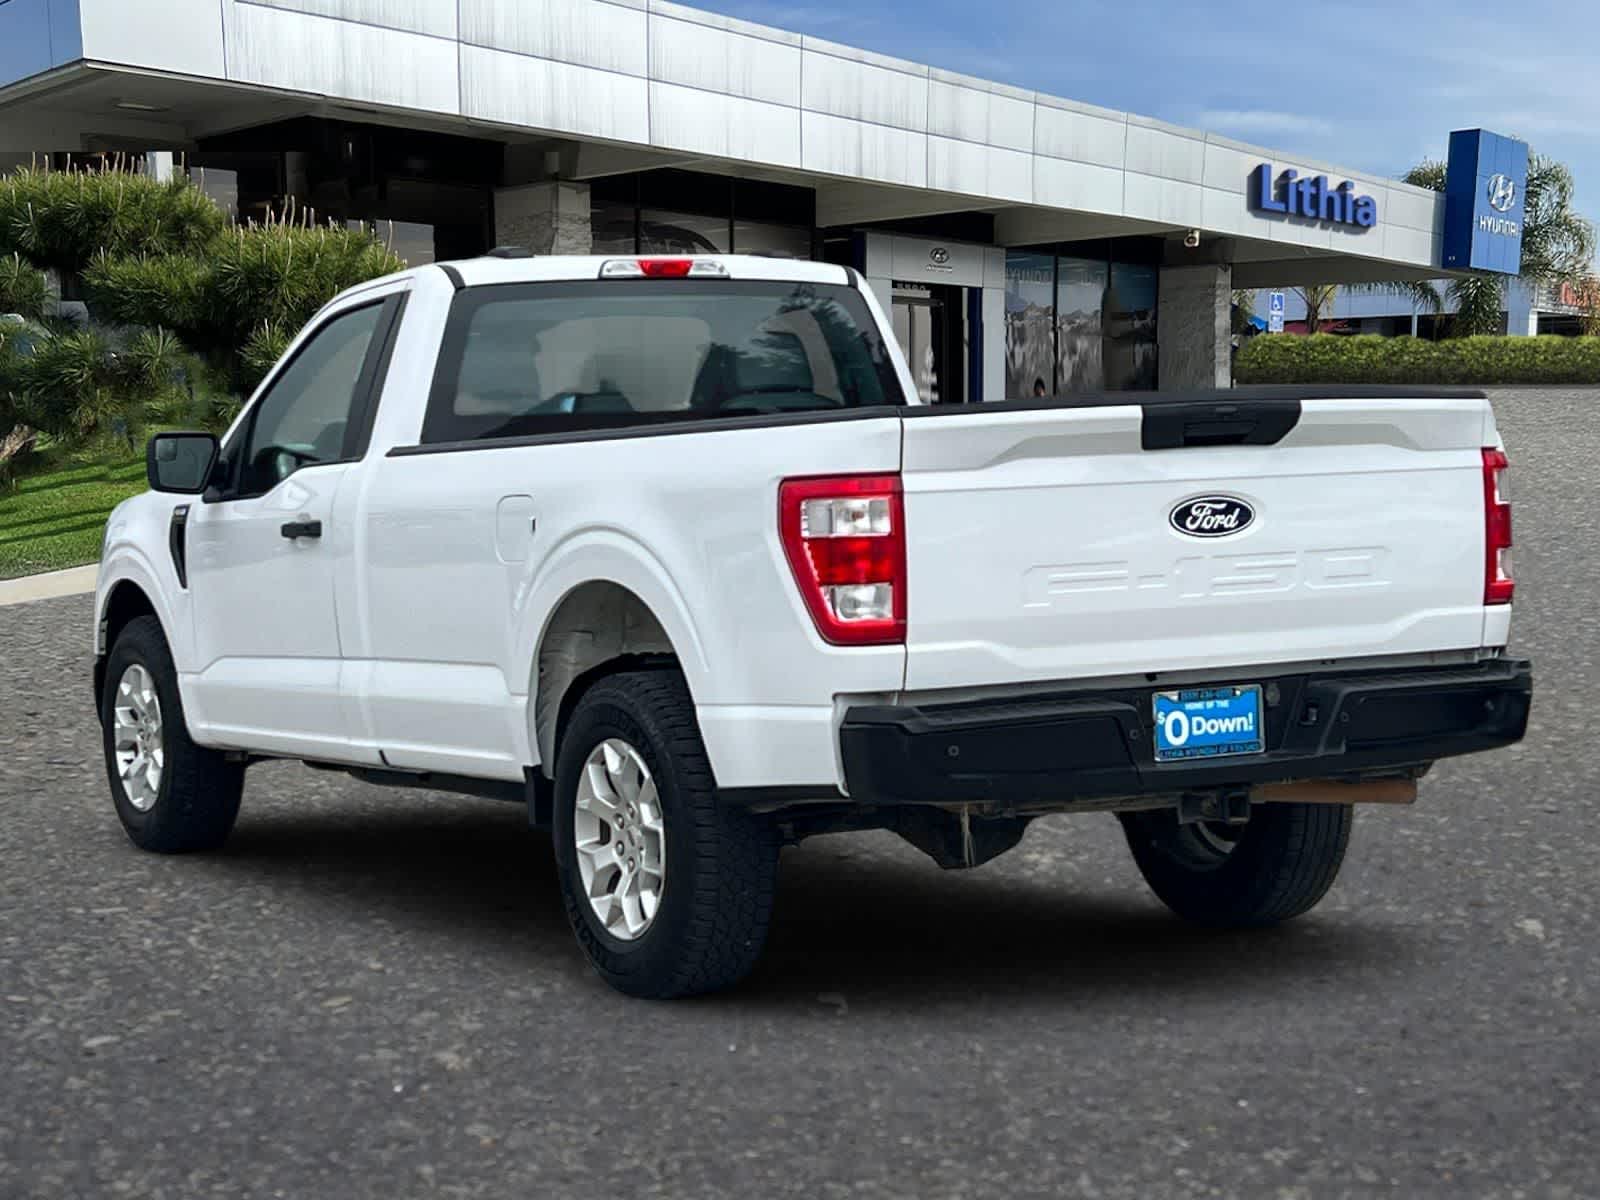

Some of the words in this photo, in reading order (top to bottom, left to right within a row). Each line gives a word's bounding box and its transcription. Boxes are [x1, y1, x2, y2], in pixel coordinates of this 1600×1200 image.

[1253, 163, 1377, 228] Lithia
[1185, 502, 1240, 530] Ford
[1191, 711, 1254, 736] Down!
